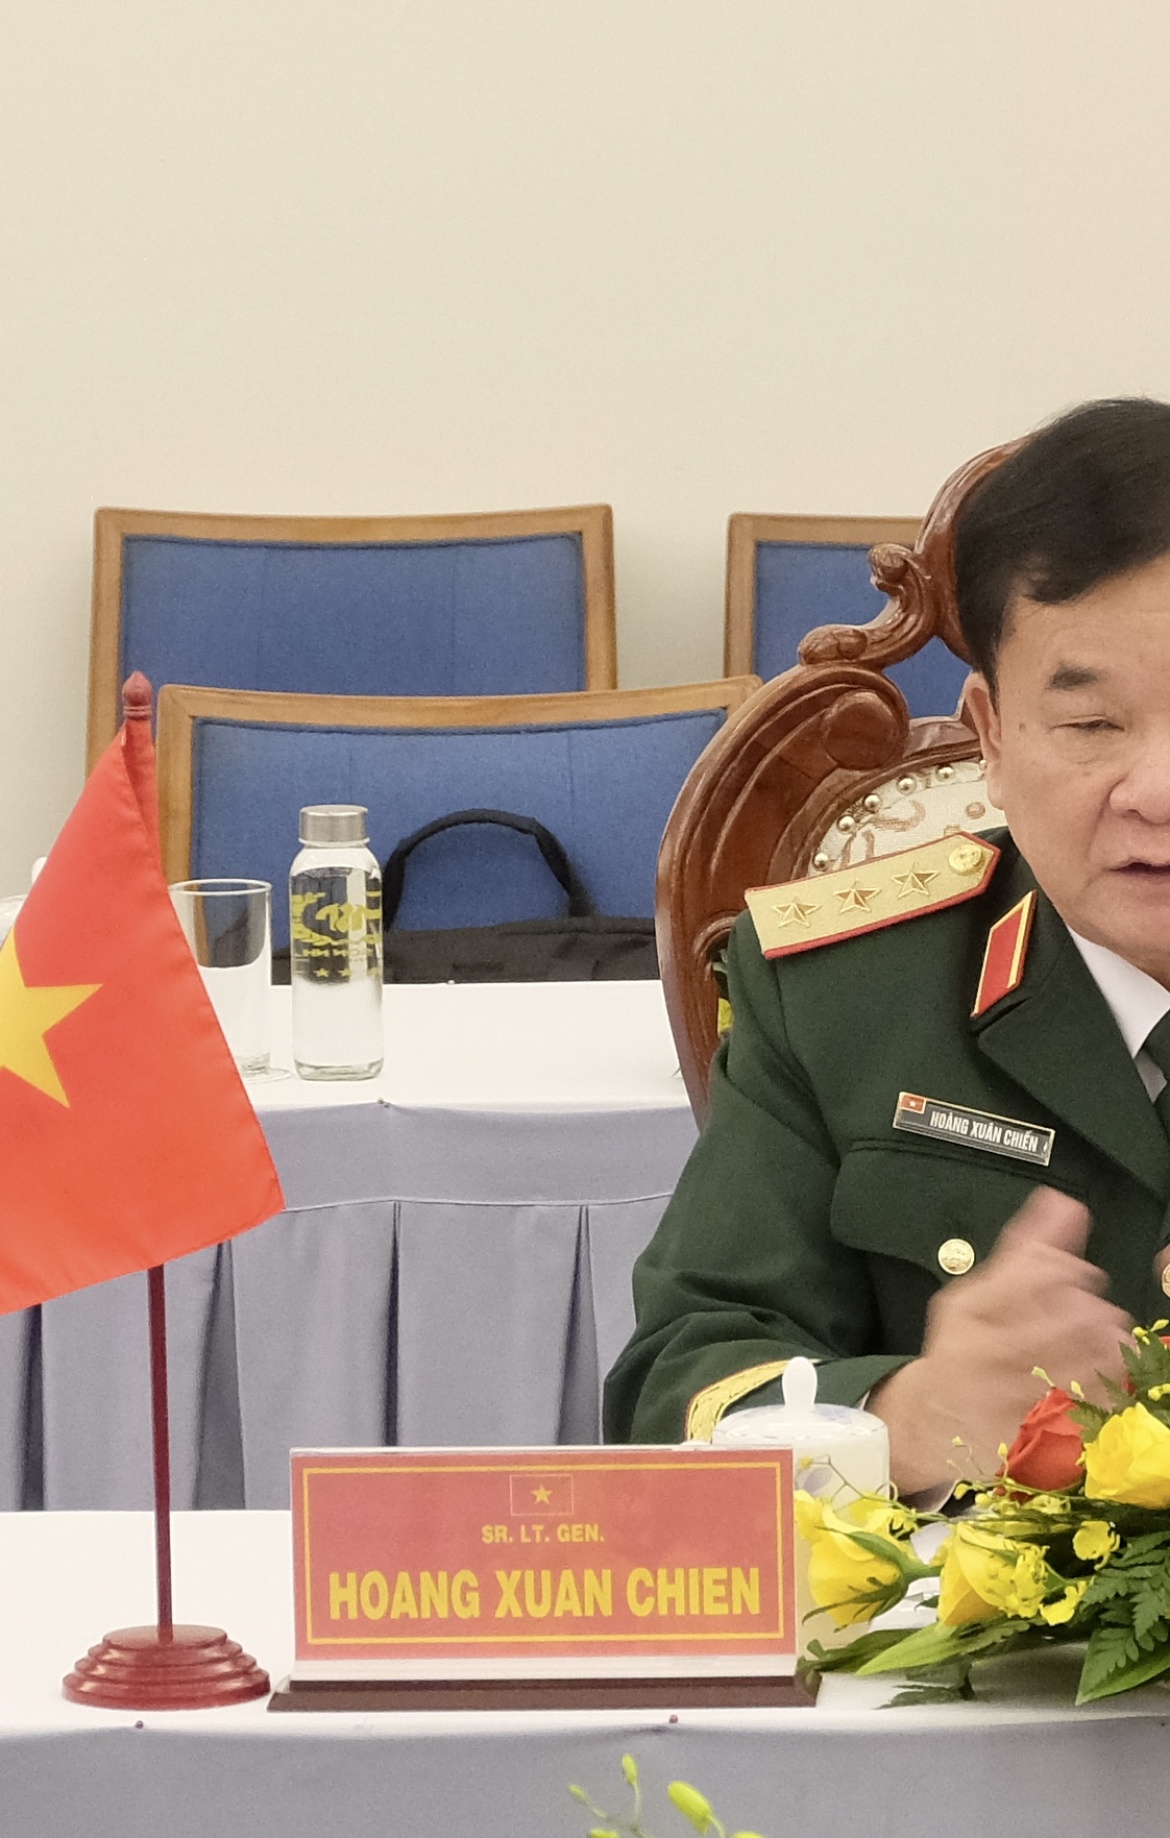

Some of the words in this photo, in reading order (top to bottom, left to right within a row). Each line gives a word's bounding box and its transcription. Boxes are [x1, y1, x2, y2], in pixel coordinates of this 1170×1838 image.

[930, 1111, 970, 1134] HOÀNG
[970, 1121, 1002, 1144] XUÂN
[481, 1524, 513, 1544] SR.
[520, 1524, 551, 1543] LT.
[556, 1522, 604, 1543] GEN.
[329, 1569, 481, 1620] HOANG
[495, 1568, 613, 1618] XUAN
[626, 1566, 761, 1617] CHIEN
